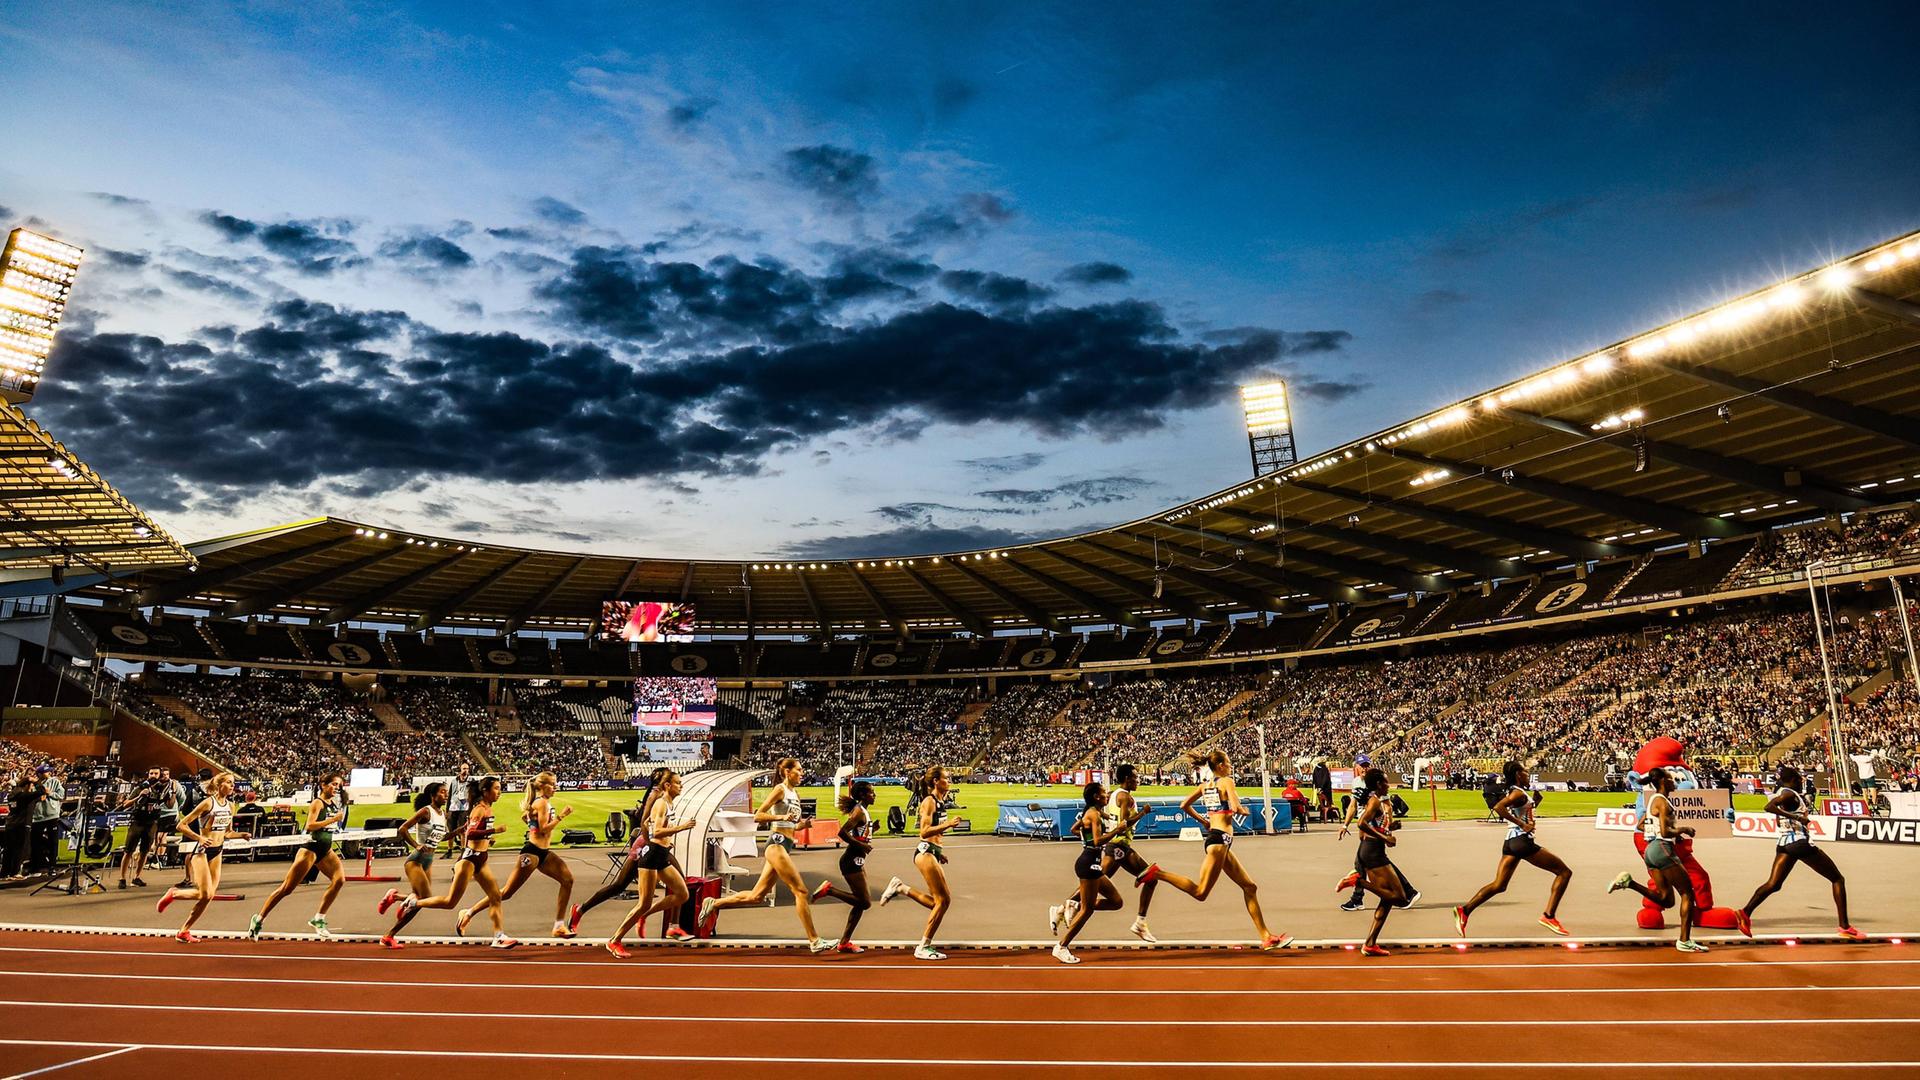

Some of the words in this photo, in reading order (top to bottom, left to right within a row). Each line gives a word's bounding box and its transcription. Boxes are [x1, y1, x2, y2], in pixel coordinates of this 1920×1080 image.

[1675, 809, 1720, 819] AMPAGNE
[1829, 801, 1863, 815] 0:38
[1154, 814, 1174, 822] Allianz
[1734, 816, 1826, 835] ONA
[1840, 819, 1920, 842] POWE
